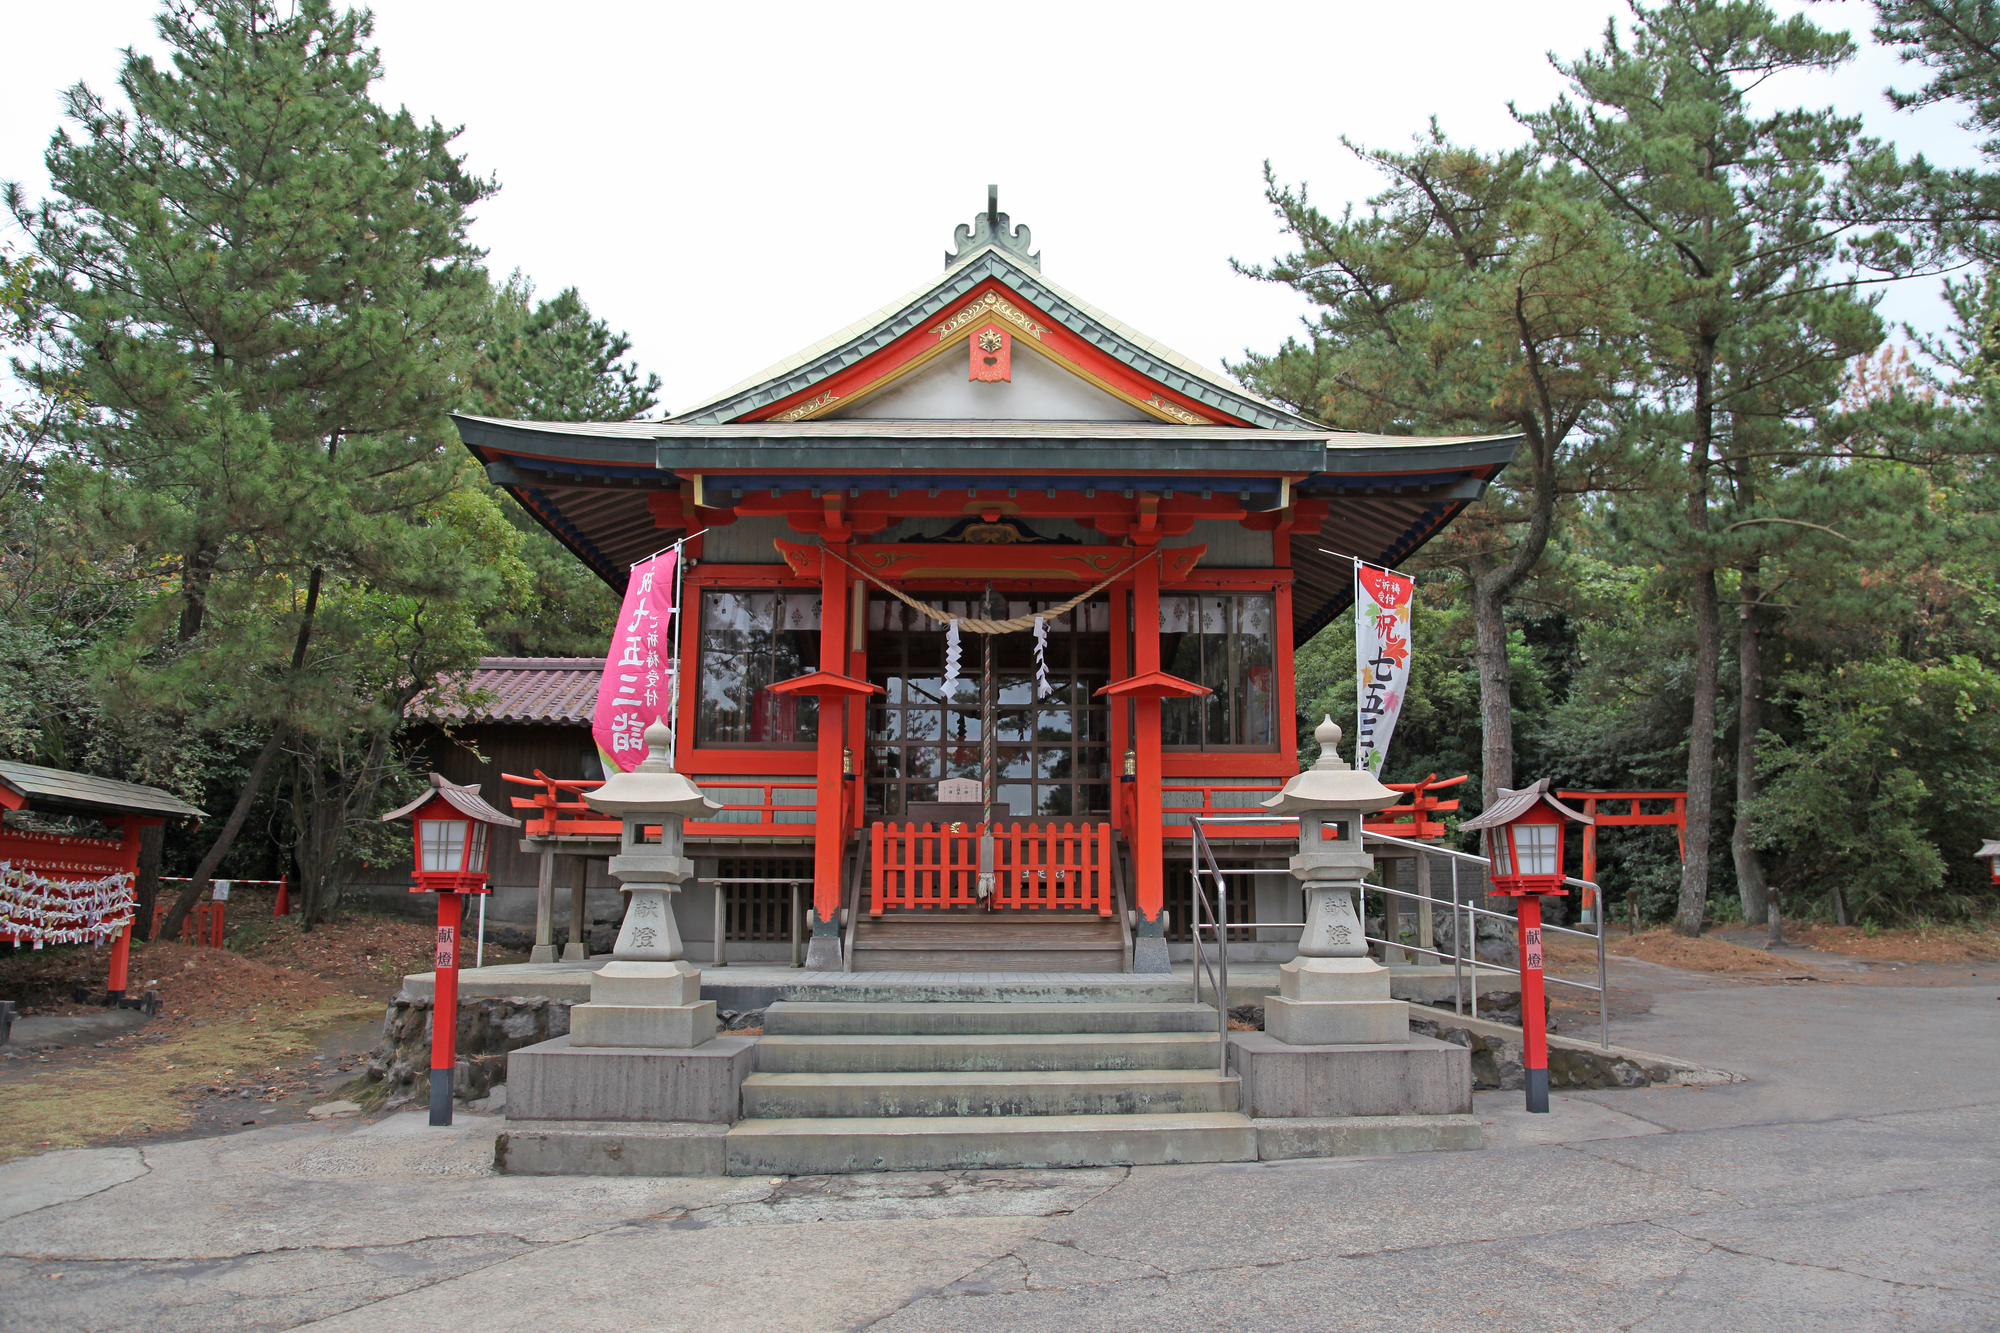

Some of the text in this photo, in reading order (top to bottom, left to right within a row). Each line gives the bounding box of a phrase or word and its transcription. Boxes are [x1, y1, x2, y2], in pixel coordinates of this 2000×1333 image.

[1374, 578, 1401, 595] ご祈祷
[1377, 590, 1396, 606] 受付
[629, 899, 659, 948] 献燈
[1324, 897, 1352, 945] 献燈
[437, 927, 454, 968] 献燈
[1526, 929, 1542, 969] 献燈
